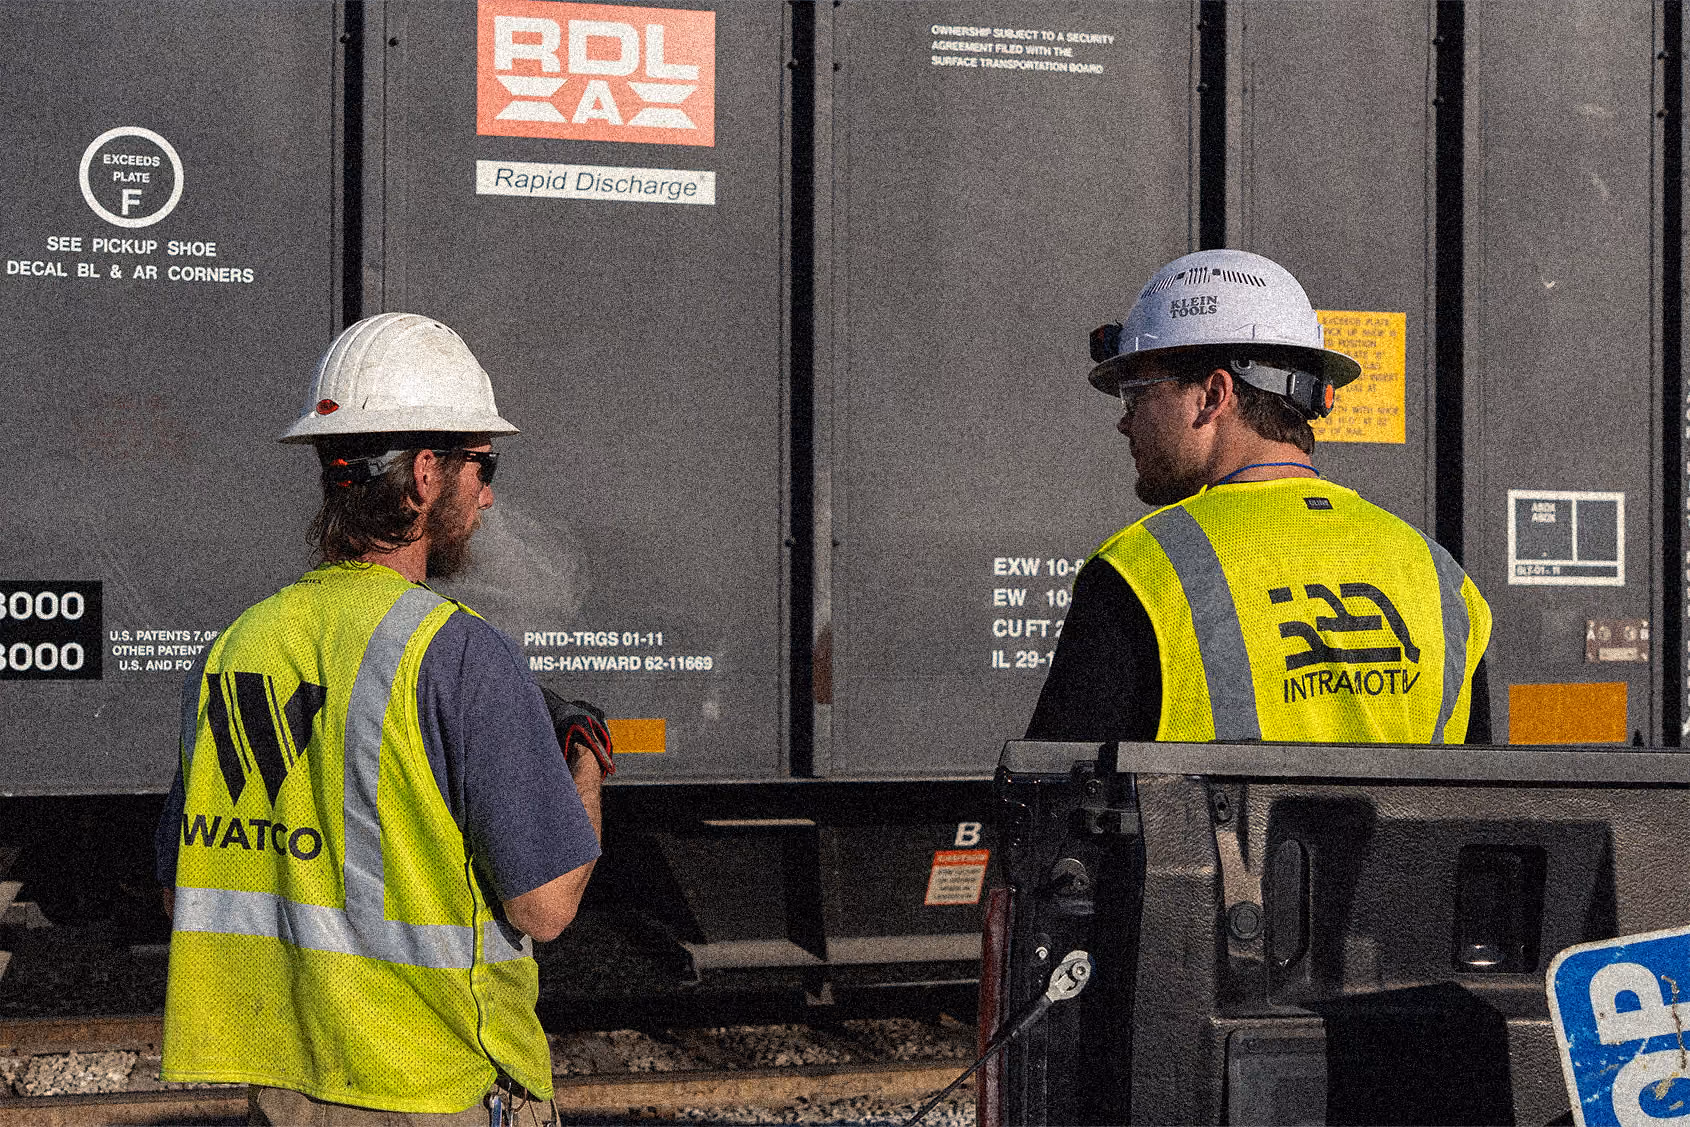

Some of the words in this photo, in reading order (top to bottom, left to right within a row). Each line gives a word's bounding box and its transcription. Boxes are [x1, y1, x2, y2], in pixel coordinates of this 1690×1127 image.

[931, 24, 992, 38] OWNERSHIP
[993, 28, 1038, 41] SUBJECT
[1041, 31, 1055, 41] TO
[1057, 32, 1065, 41] A
[1066, 33, 1115, 45] SECURITY
[494, 15, 700, 81] RDL
[931, 40, 993, 53] AGREEMENT
[995, 43, 1025, 54] FILED
[1025, 45, 1053, 56] WITH
[1053, 46, 1074, 58] THE
[931, 55, 979, 68] SURFACE
[980, 58, 1069, 72] TRANSPORTATION
[1069, 64, 1104, 74] BOARD
[103, 153, 161, 167] EXCEEDS
[113, 171, 150, 184] PLATE
[495, 168, 567, 193] Rapid
[576, 172, 698, 200] Discharge
[121, 188, 143, 216] F
[47, 236, 82, 252] SEE
[93, 238, 158, 255] PICKUP
[167, 241, 217, 257] SHOE
[7, 260, 68, 278] DECAL
[77, 263, 100, 279] BL
[110, 264, 122, 280] &
[133, 265, 158, 281] AR
[167, 266, 254, 284] CORNERS
[1170, 295, 1219, 308] KLEIN
[1170, 304, 1218, 319] TOOLS
[993, 557, 1041, 577] EXW
[993, 588, 1027, 608] EW
[109, 630, 133, 641] U.S.
[136, 630, 190, 641] PATENTS
[524, 631, 619, 647] PNTD-TRGS
[622, 631, 664, 647] 01-11
[112, 645, 155, 656] OTHER
[991, 649, 1011, 669] IL
[119, 660, 142, 671] U.S.
[145, 660, 172, 671] AND
[175, 660, 195, 671] FO
[529, 656, 641, 671] MS-HAYWARD
[645, 656, 713, 671] 62-11669
[182, 813, 323, 861] WATCO
[954, 822, 982, 847] B
